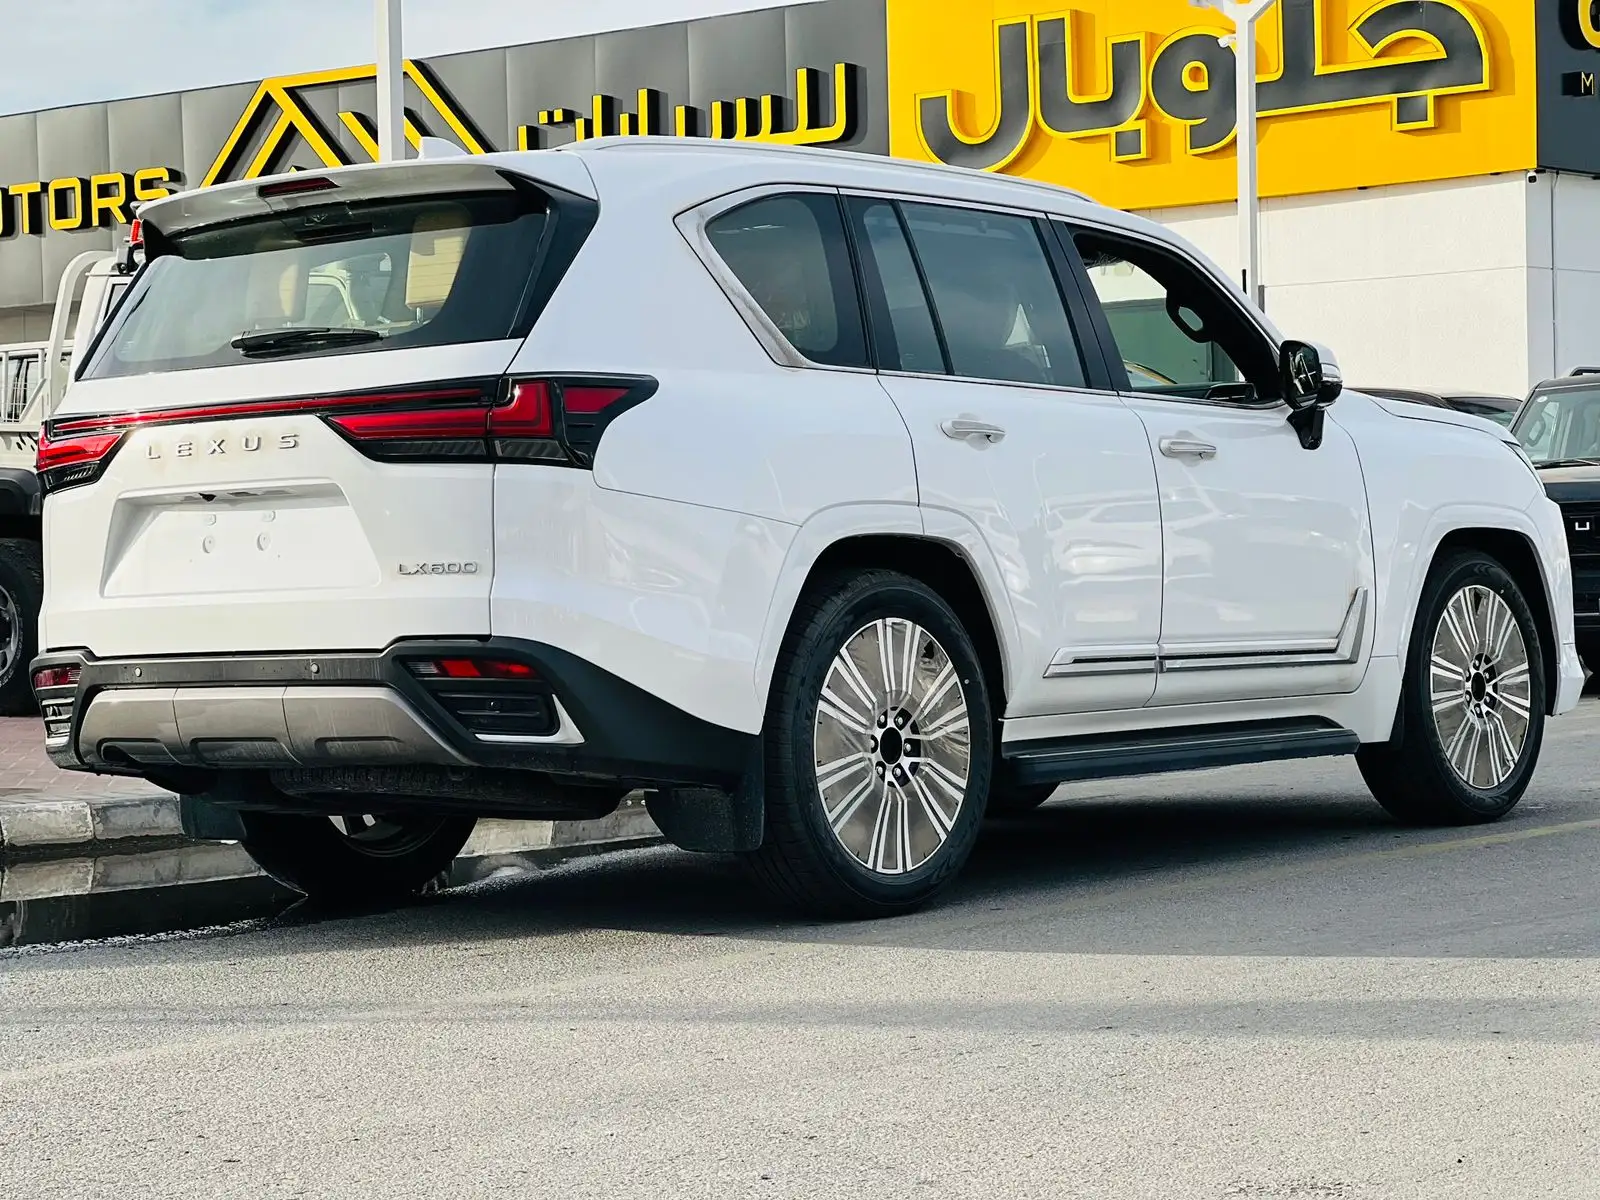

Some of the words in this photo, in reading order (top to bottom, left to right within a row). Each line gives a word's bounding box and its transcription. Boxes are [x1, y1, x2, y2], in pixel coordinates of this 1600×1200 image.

[0, 166, 170, 236] TORS
[145, 432, 300, 460] LEXUS
[398, 561, 479, 576] LX600
